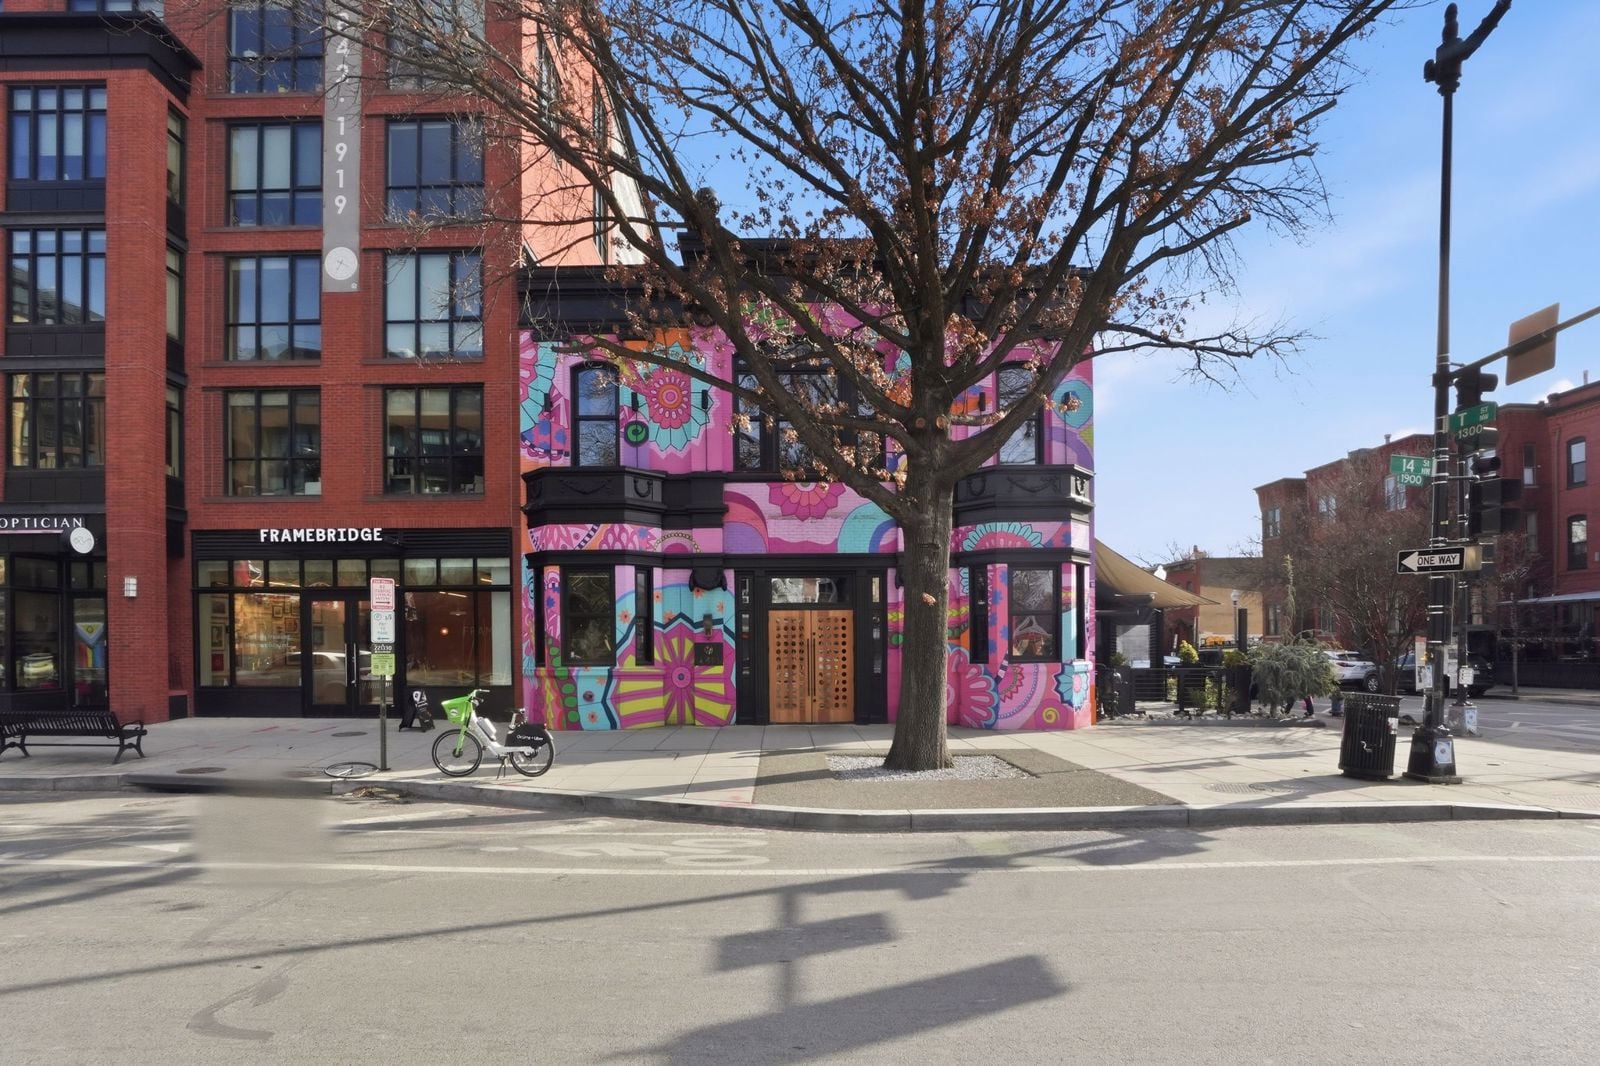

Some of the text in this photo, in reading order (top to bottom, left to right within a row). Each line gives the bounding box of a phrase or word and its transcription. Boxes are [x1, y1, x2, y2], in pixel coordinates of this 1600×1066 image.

[1457, 405, 1488, 427] T ST
[1457, 423, 1483, 439] 1300
[1402, 458, 1415, 473] 14
[1400, 473, 1422, 484] 1900
[0, 517, 82, 528] OPTICIAN
[259, 527, 383, 542] FRAMEBRIDGE
[1417, 554, 1457, 566] ONE WAY
